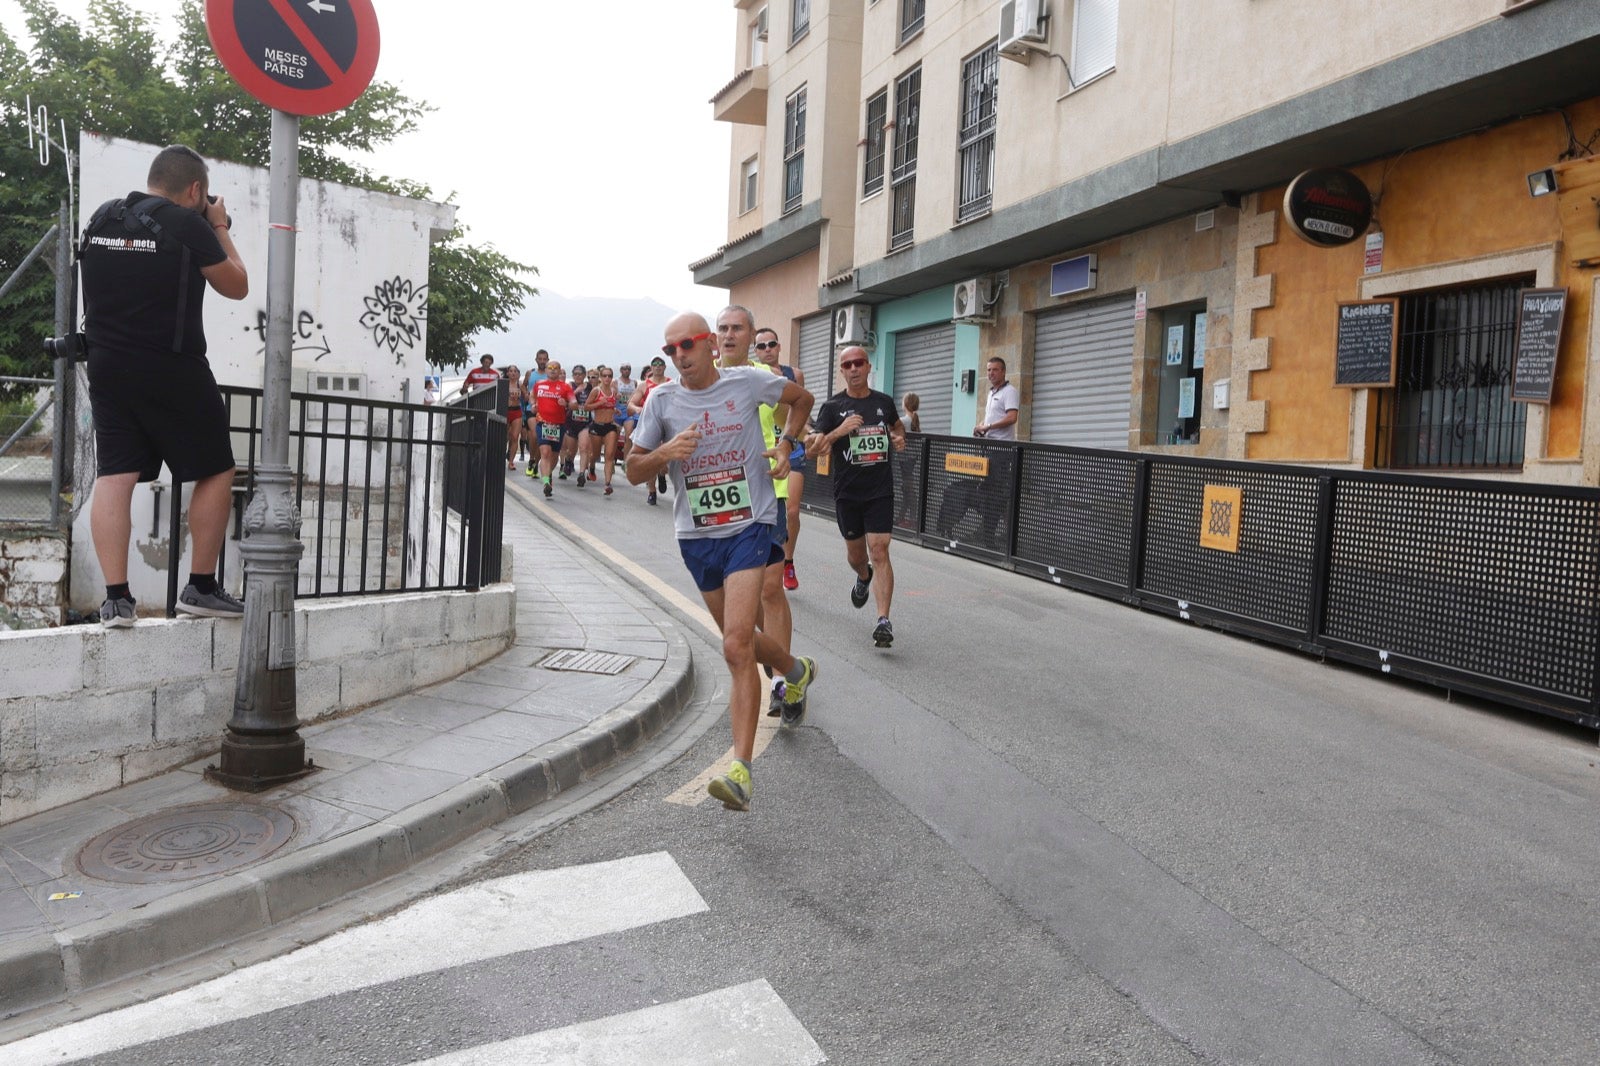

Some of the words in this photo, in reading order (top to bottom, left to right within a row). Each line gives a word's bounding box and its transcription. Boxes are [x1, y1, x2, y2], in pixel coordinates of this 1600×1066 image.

[264, 47, 308, 67] MESES
[264, 60, 304, 79] PARES
[716, 423, 743, 433] FONDO
[857, 437, 884, 451] 495
[699, 485, 741, 510] 496
